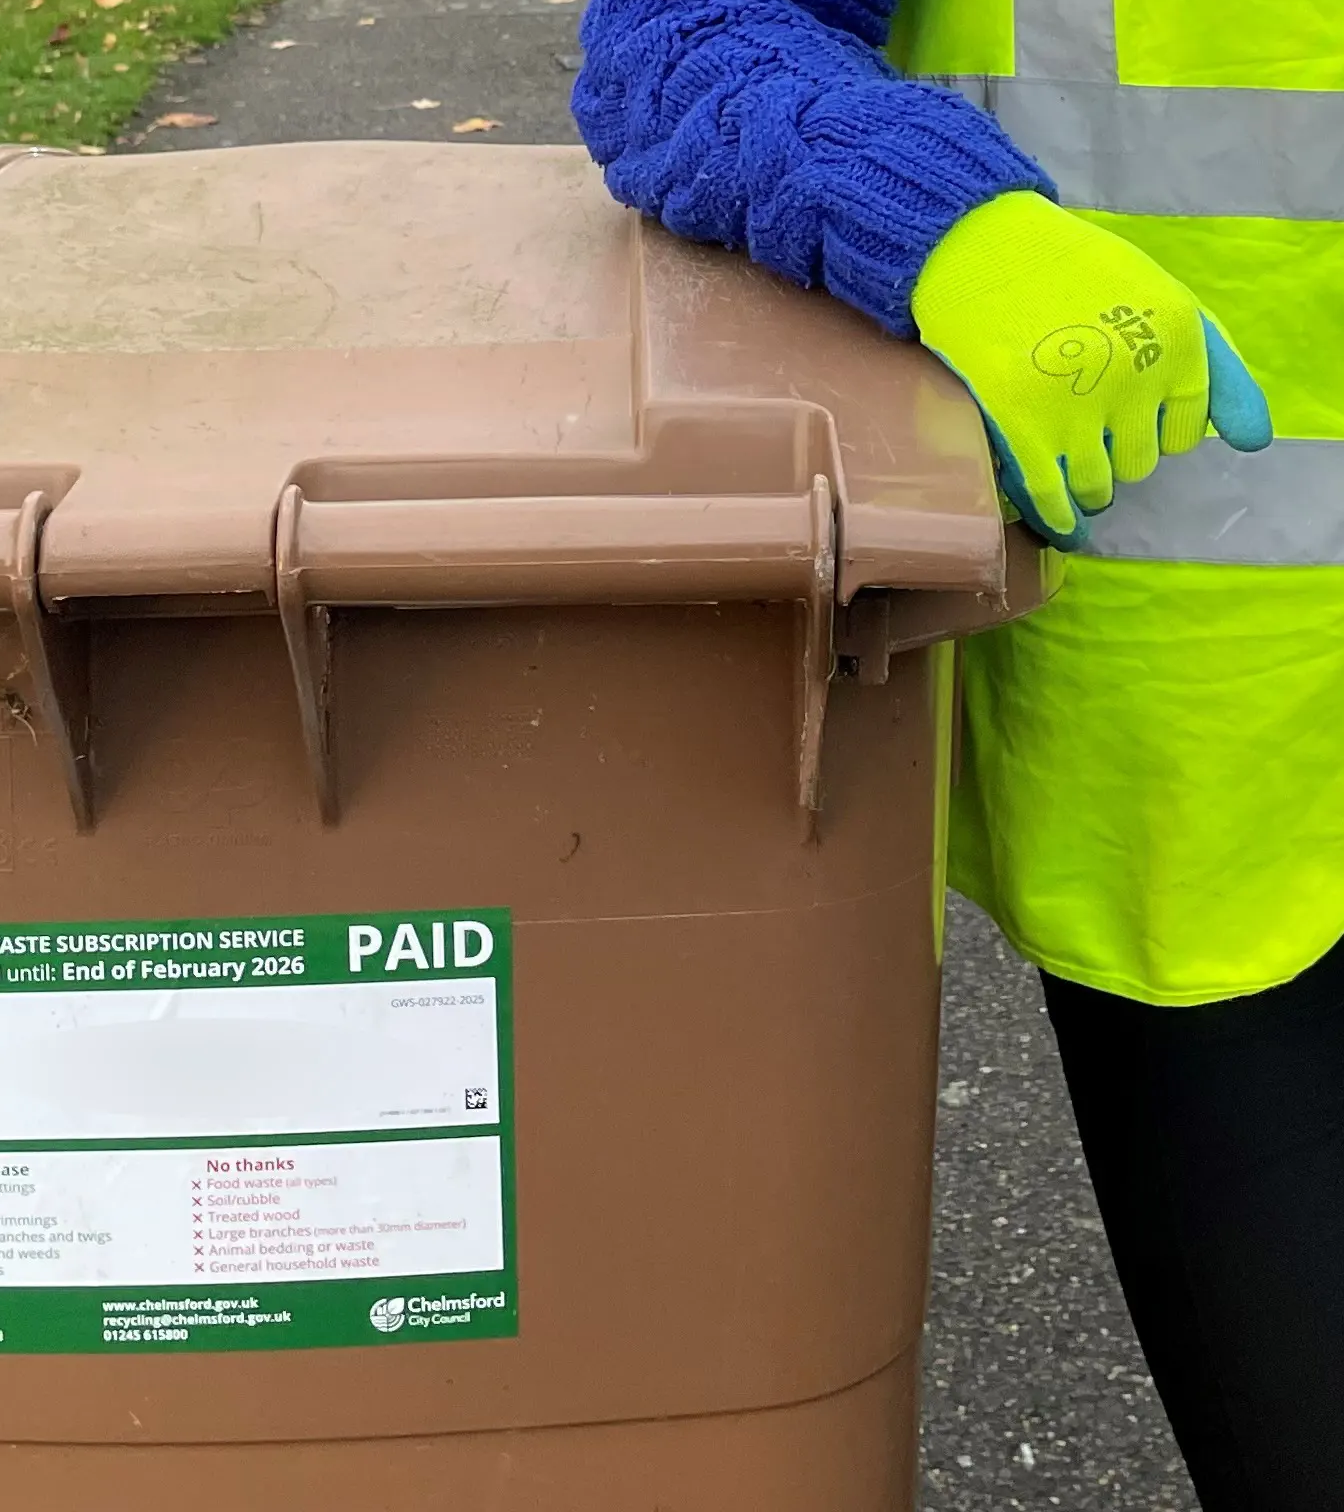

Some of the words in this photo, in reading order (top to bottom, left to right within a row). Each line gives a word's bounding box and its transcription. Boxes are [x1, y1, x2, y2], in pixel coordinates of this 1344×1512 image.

[1098, 305, 1164, 374] size
[1031, 324, 1113, 396] 9
[56, 931, 213, 953] SUBSCRIPTION
[219, 929, 305, 949] SERVICE
[348, 920, 494, 973] PAID
[7, 963, 56, 982] until:
[62, 961, 104, 981] End
[111, 959, 136, 980] of
[141, 958, 246, 982] February
[251, 956, 305, 977] 2026
[207, 1159, 230, 1173] No
[235, 1157, 295, 1172] thanks
[206, 1178, 240, 1190] Food
[244, 1178, 283, 1188] waste
[208, 1210, 259, 1223] Treated
[263, 1209, 301, 1221] wood
[49, 1231, 74, 1242] and
[78, 1231, 113, 1245] twigs
[208, 1228, 246, 1242] Large
[249, 1227, 312, 1239] branches
[349, 1225, 374, 1235] than
[18, 1248, 60, 1259] weeds
[208, 1243, 255, 1257] Animal
[259, 1242, 314, 1256] bedding
[317, 1243, 331, 1253] or
[335, 1240, 375, 1251] waste
[209, 1260, 262, 1273] General
[266, 1257, 337, 1271] household
[341, 1256, 380, 1268] waste
[102, 1297, 259, 1313] www.chelmsford.gov.uk
[407, 1291, 506, 1313] Chelmsford
[103, 1310, 292, 1329] recycling@chelmsford.gov.uk
[408, 1315, 430, 1327] City
[431, 1312, 471, 1324] Council
[103, 1329, 141, 1342] 01245
